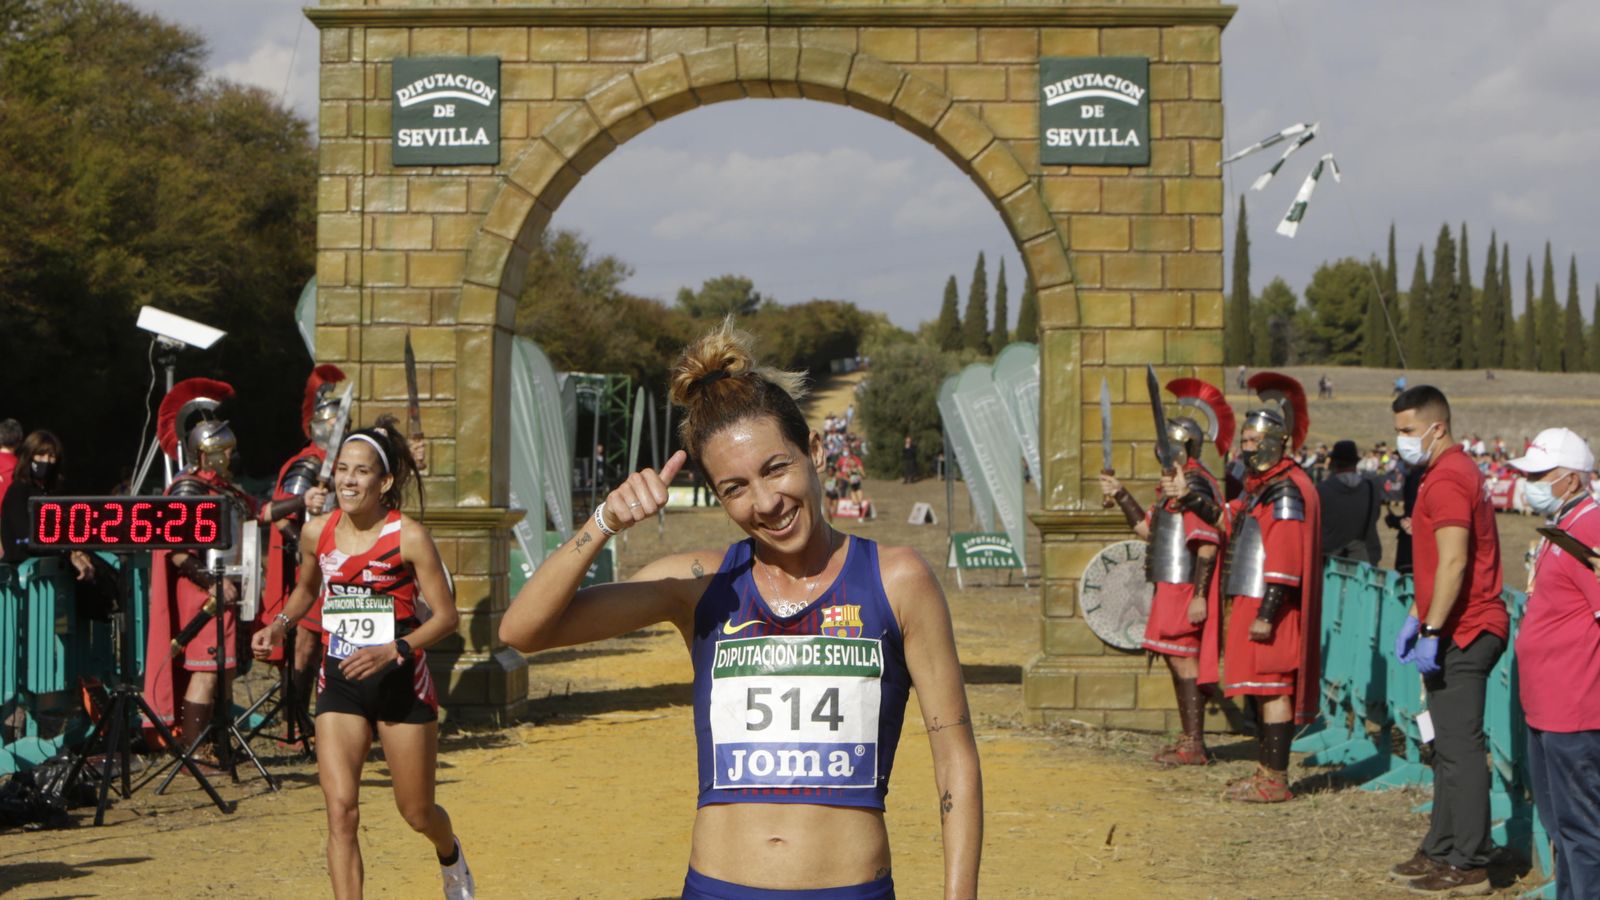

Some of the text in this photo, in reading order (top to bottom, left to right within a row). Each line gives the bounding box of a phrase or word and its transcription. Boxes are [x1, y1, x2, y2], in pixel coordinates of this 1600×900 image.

[396, 73, 497, 101] DIPUTACION
[1043, 73, 1145, 101] DIPUTACION
[433, 104, 456, 117] DE
[1081, 105, 1104, 118] DE
[397, 127, 490, 147] SEVILLA
[1046, 128, 1140, 147] SEVILLA
[39, 503, 217, 543] 00:26:26
[966, 557, 1015, 567] SEVILLA
[356, 599, 364, 608] DE
[365, 598, 393, 609] SEVILLA
[335, 618, 375, 640] 479
[717, 644, 879, 668] DIPUTACION DE SEVILLA
[746, 687, 844, 731] 514
